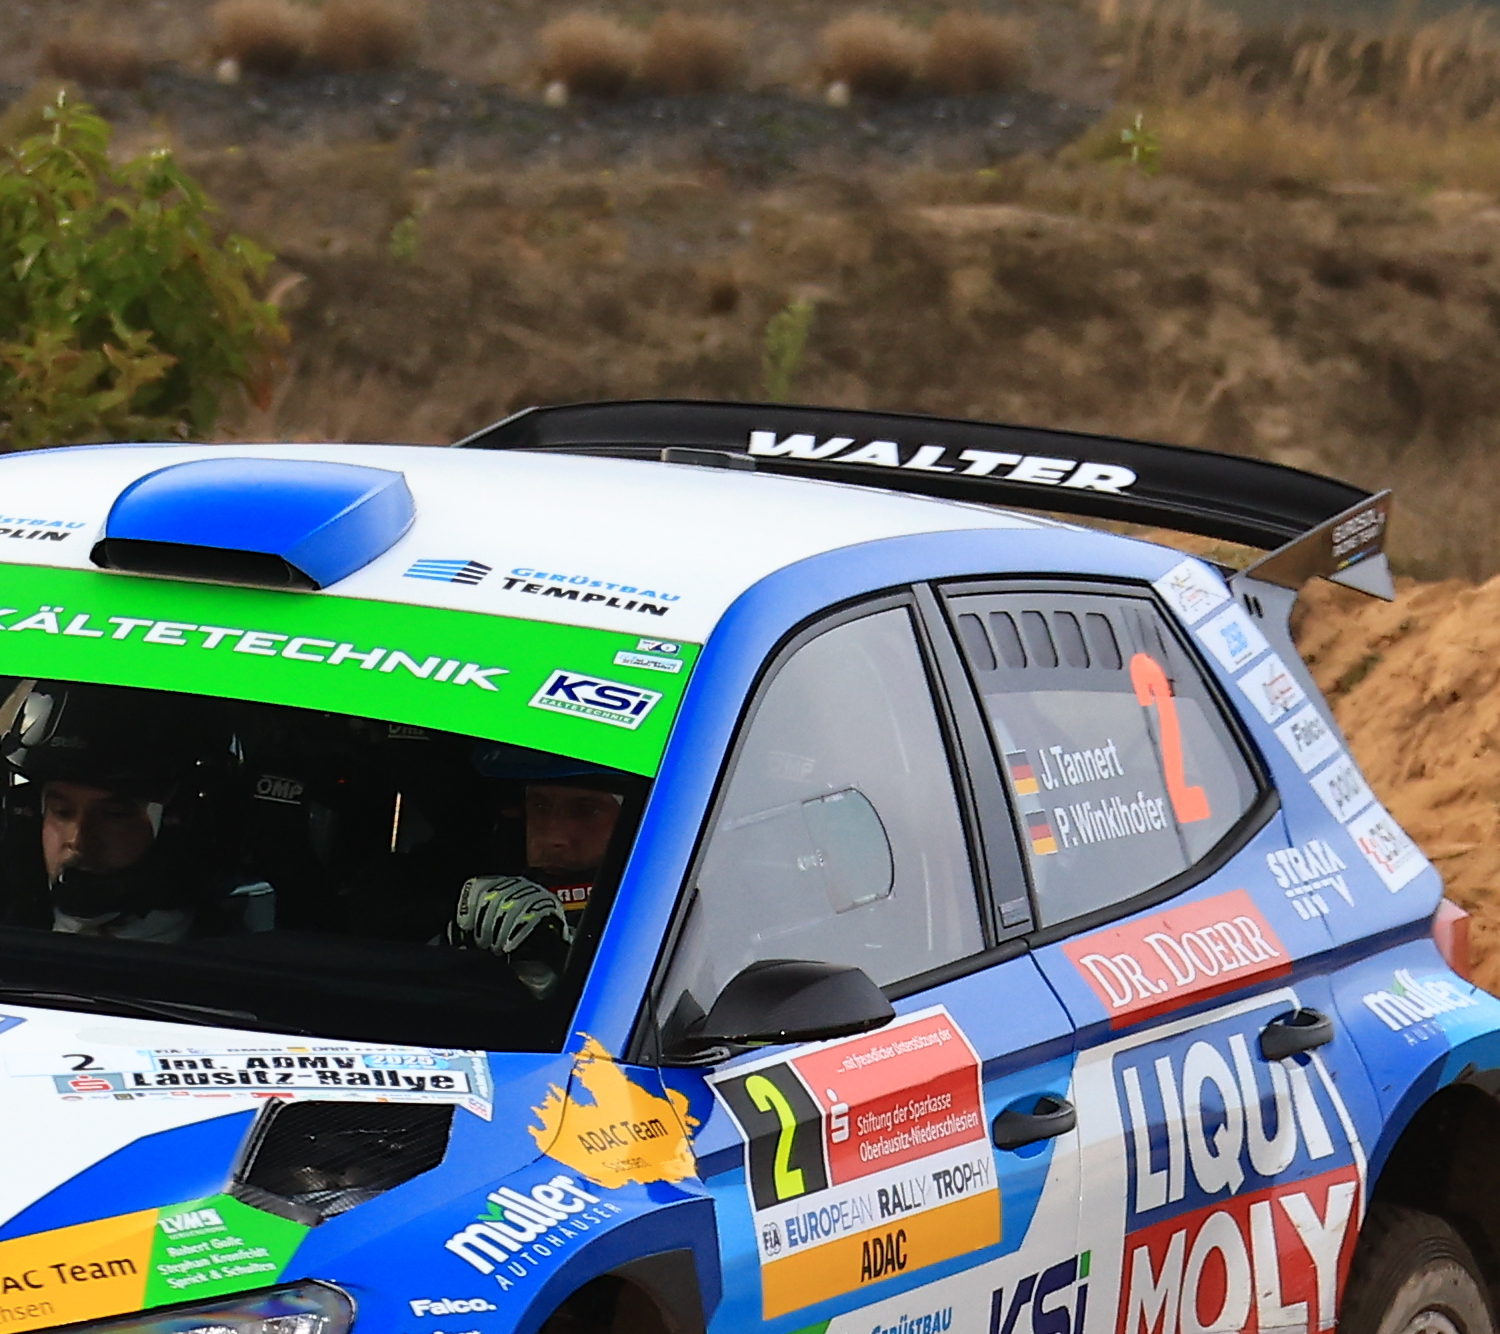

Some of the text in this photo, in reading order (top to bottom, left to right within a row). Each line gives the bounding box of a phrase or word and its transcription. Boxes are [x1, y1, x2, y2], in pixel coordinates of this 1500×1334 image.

[749, 430, 1138, 494] WALTER
[501, 577, 670, 617] TEMPLIN
[1130, 652, 1211, 824] 2
[257, 778, 303, 800] OMP
[1080, 915, 1281, 1008] DR. DOERR
[62, 1054, 105, 1071] 2
[133, 1070, 454, 1091] Lausitz-Rallye
[158, 1058, 228, 1070] Int.
[373, 1054, 435, 1066] 2025
[578, 1118, 669, 1155] ADAC Team
[746, 1075, 806, 1201] 2
[857, 1092, 951, 1137] Stiftung der Sparkasse
[860, 1110, 979, 1162] Oberlausitz-Niederschlesien
[1123, 1033, 1335, 1214] LIQUI
[786, 1195, 873, 1248] EUROPEAN
[878, 1177, 928, 1218] RALLY
[933, 1157, 990, 1197] TROPHY
[54, 1255, 138, 1285] Team
[495, 1201, 622, 1292] AUTOHÄUSER
[861, 1229, 907, 1283] ADAC
